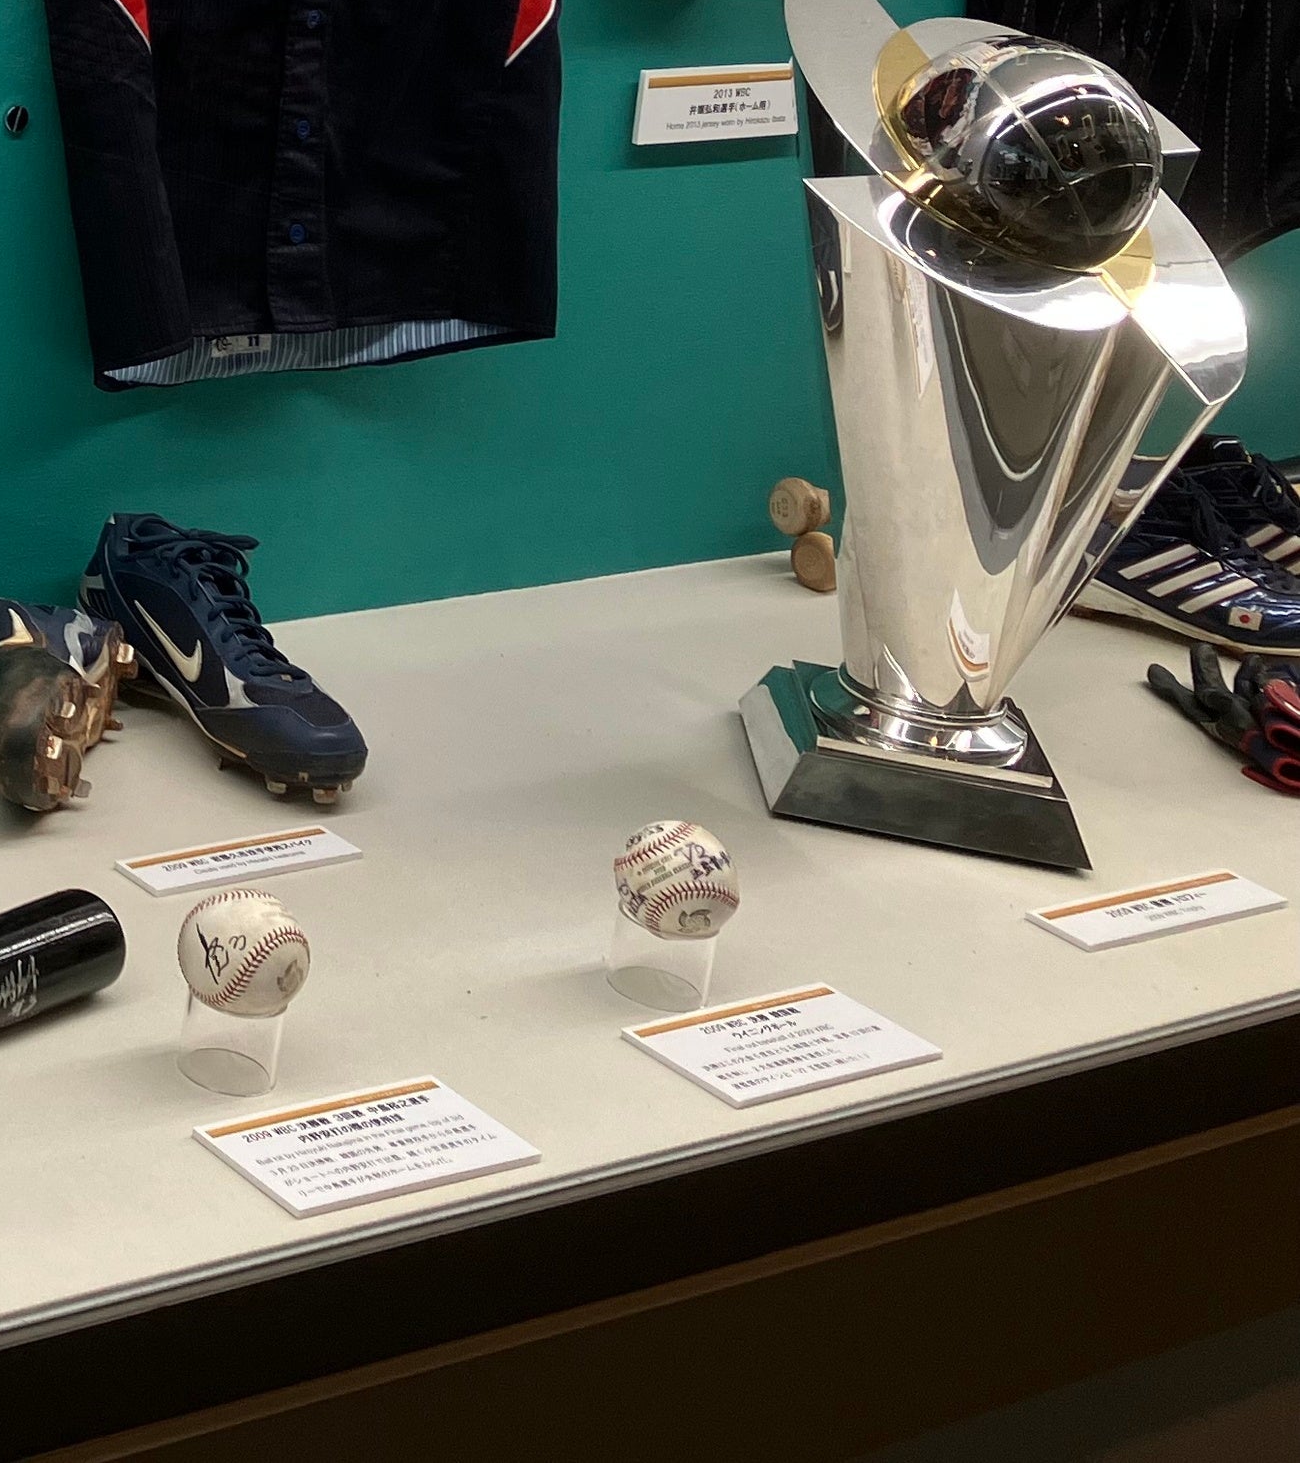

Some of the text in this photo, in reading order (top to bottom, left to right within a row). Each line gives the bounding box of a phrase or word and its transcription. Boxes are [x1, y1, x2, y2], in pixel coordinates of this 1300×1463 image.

[713, 87, 751, 99] 2013 WBC
[242, 1130, 273, 1143] 2009
[272, 1124, 297, 1138] WBC
